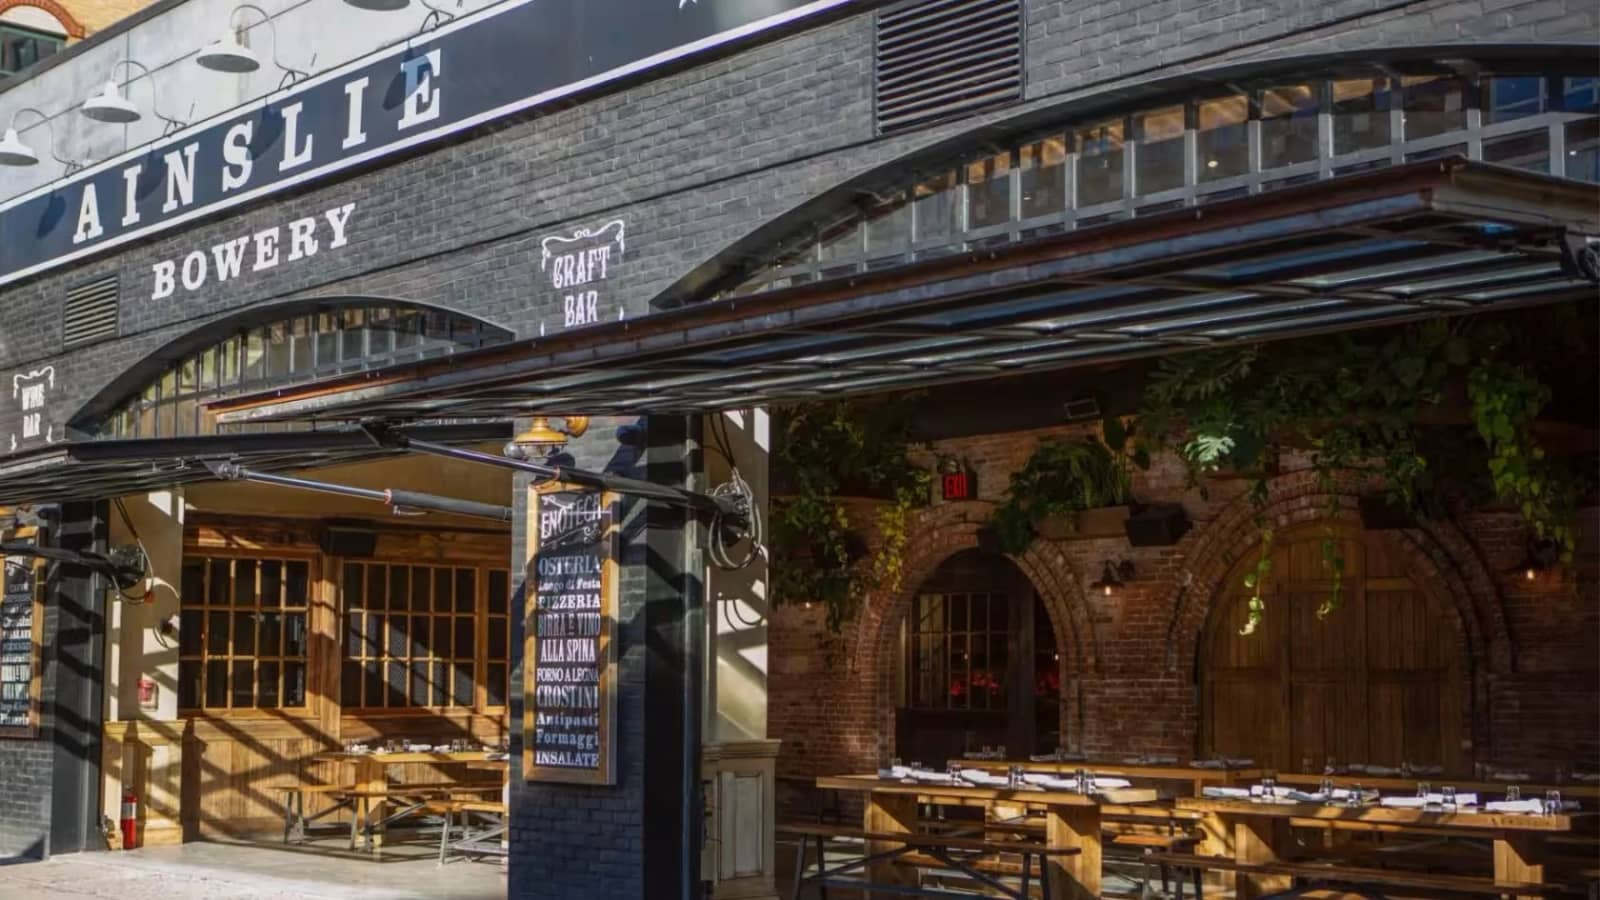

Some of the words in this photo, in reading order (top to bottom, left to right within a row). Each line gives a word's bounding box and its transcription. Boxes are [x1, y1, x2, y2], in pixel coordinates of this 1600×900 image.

[73, 48, 441, 244] AINSLIE
[151, 203, 356, 300] BOWERY
[553, 245, 611, 289] CRAFT
[564, 290, 598, 327] BAR
[23, 413, 41, 438] BAR
[944, 473, 968, 498] EXIT
[541, 493, 602, 539] ENOTECA
[538, 555, 602, 576] OSTERIA
[576, 578, 601, 590] Festa
[538, 594, 601, 610] PIZZERIA
[540, 638, 565, 662] ALLA
[566, 638, 596, 662] SPINA
[565, 668, 571, 682] A
[536, 684, 599, 708] CROSTINI
[536, 712, 599, 730] Antipasti
[536, 729, 599, 750] Formaggi
[535, 751, 600, 767] INSALATE
